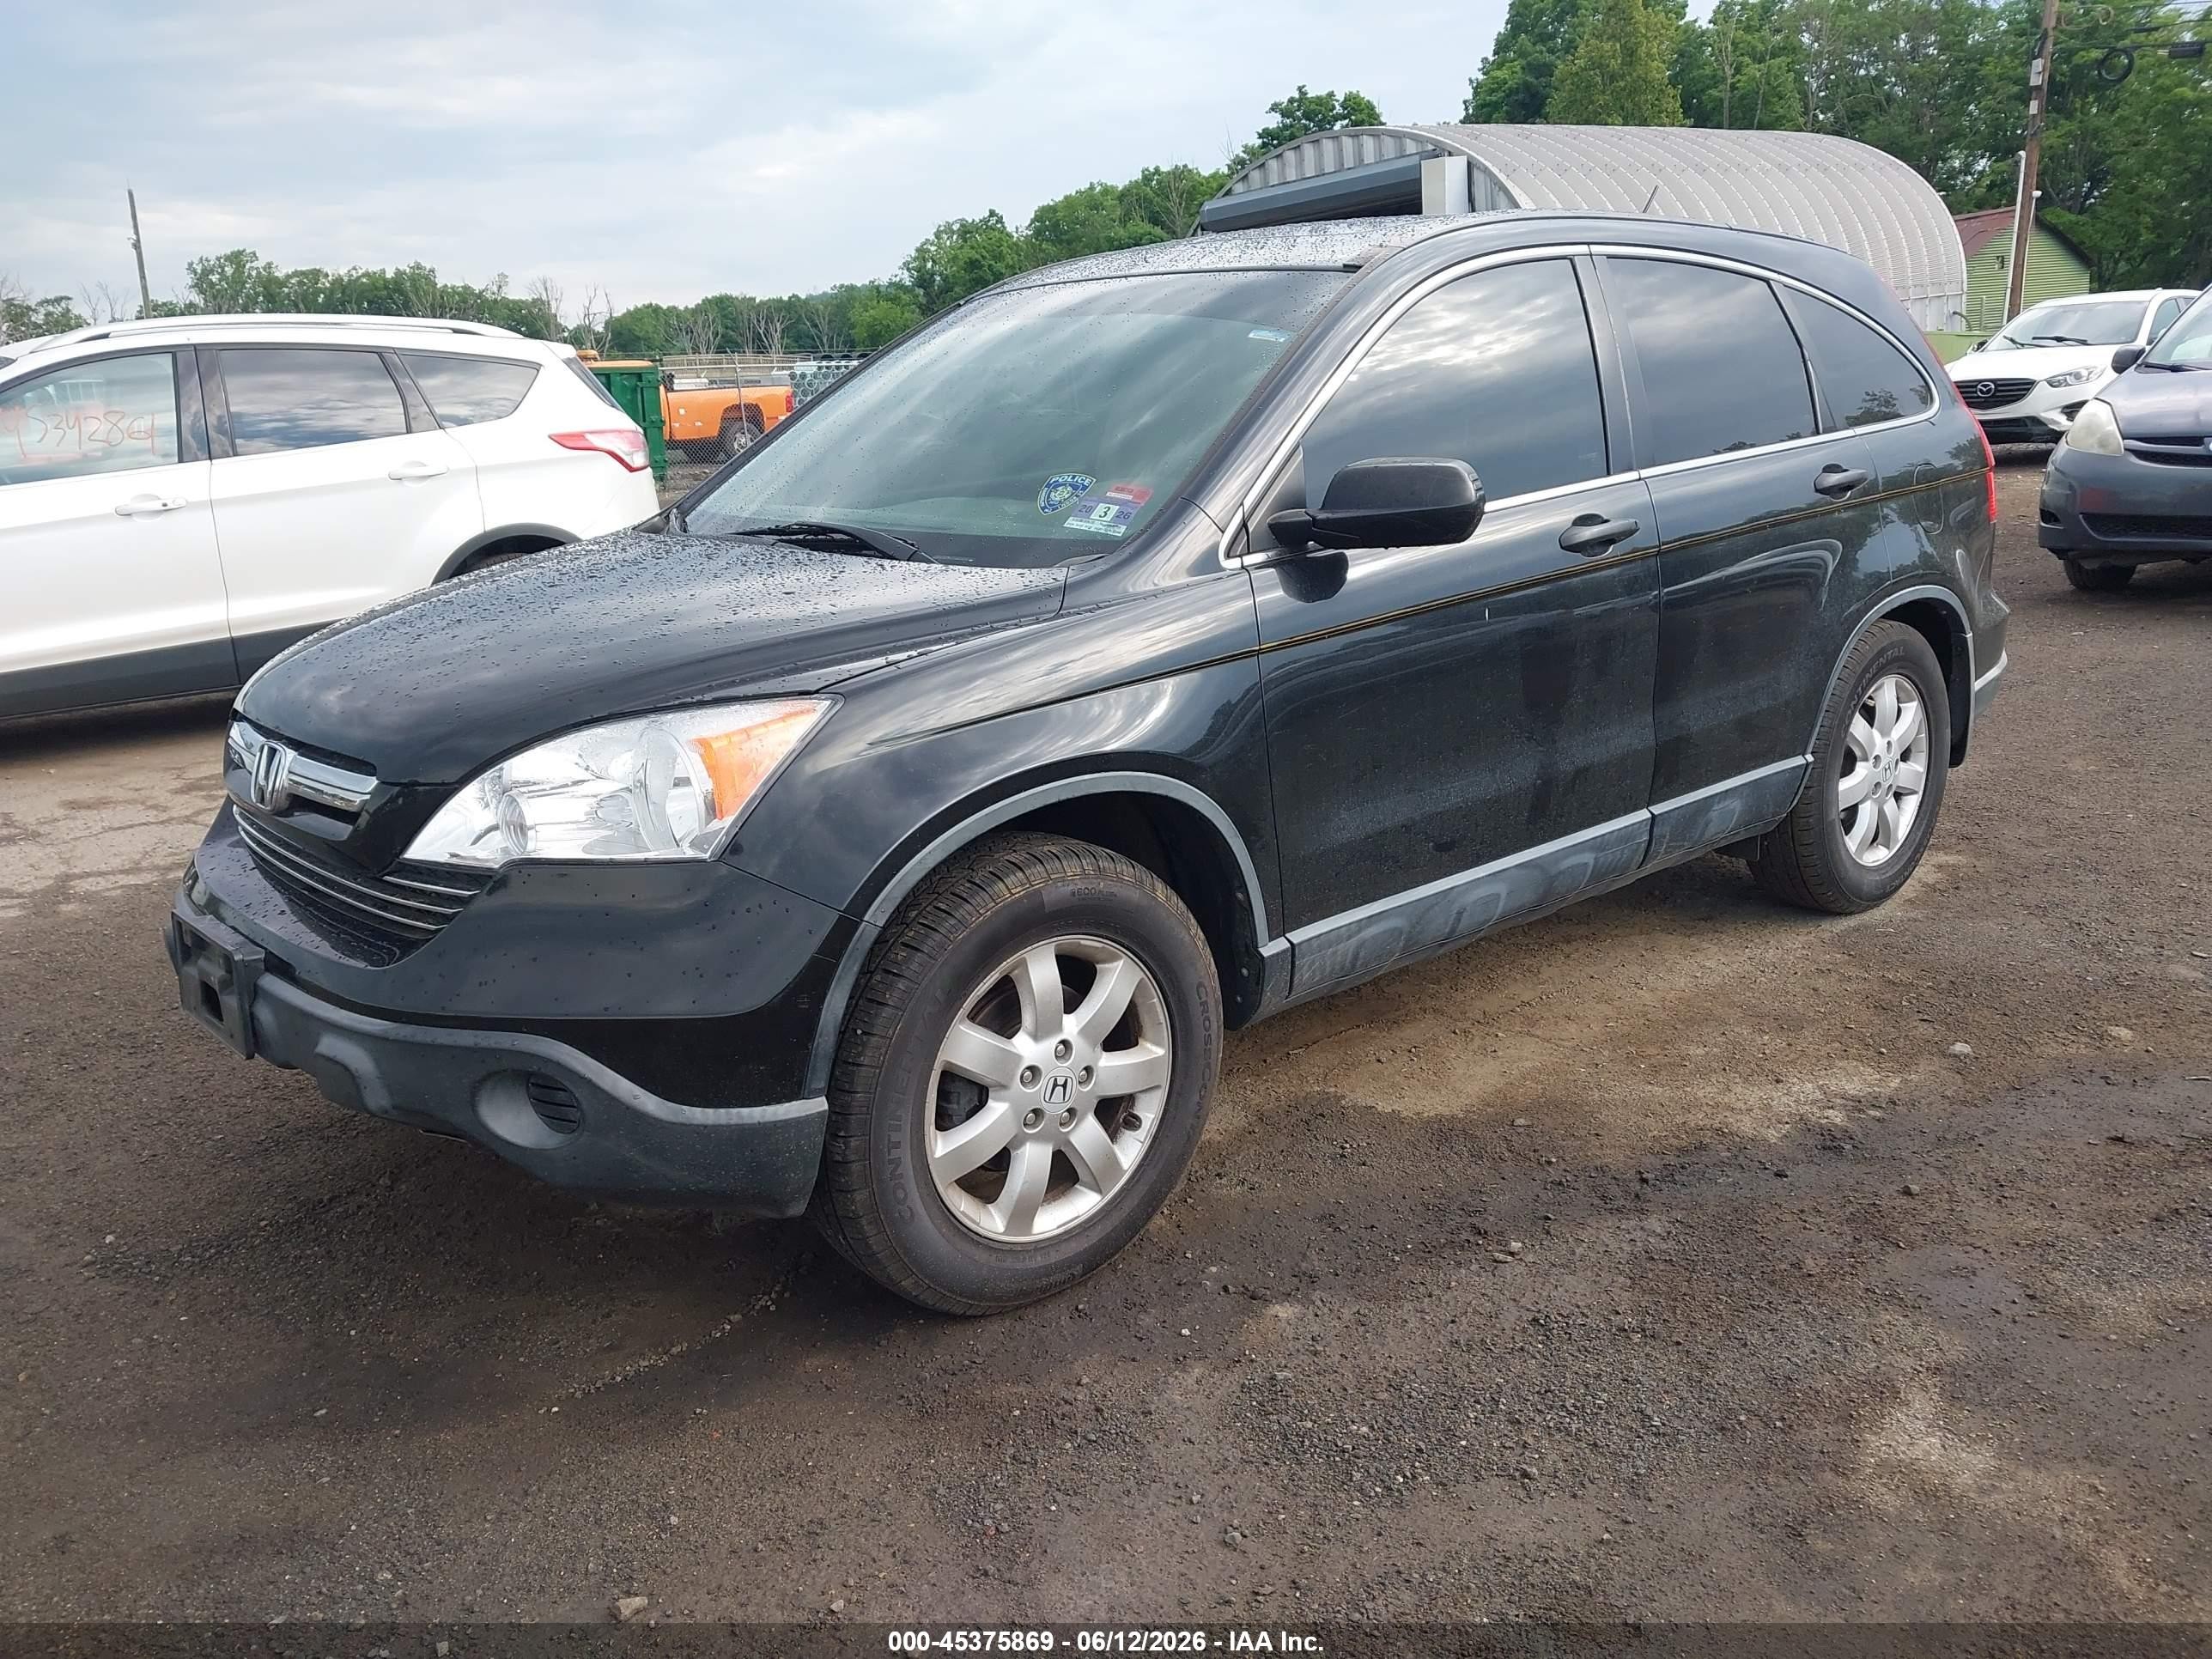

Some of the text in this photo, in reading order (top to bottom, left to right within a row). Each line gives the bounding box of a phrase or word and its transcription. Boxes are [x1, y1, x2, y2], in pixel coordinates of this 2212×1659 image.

[1050, 475, 1092, 487] POLICE
[1079, 504, 1132, 520] 20 3 26
